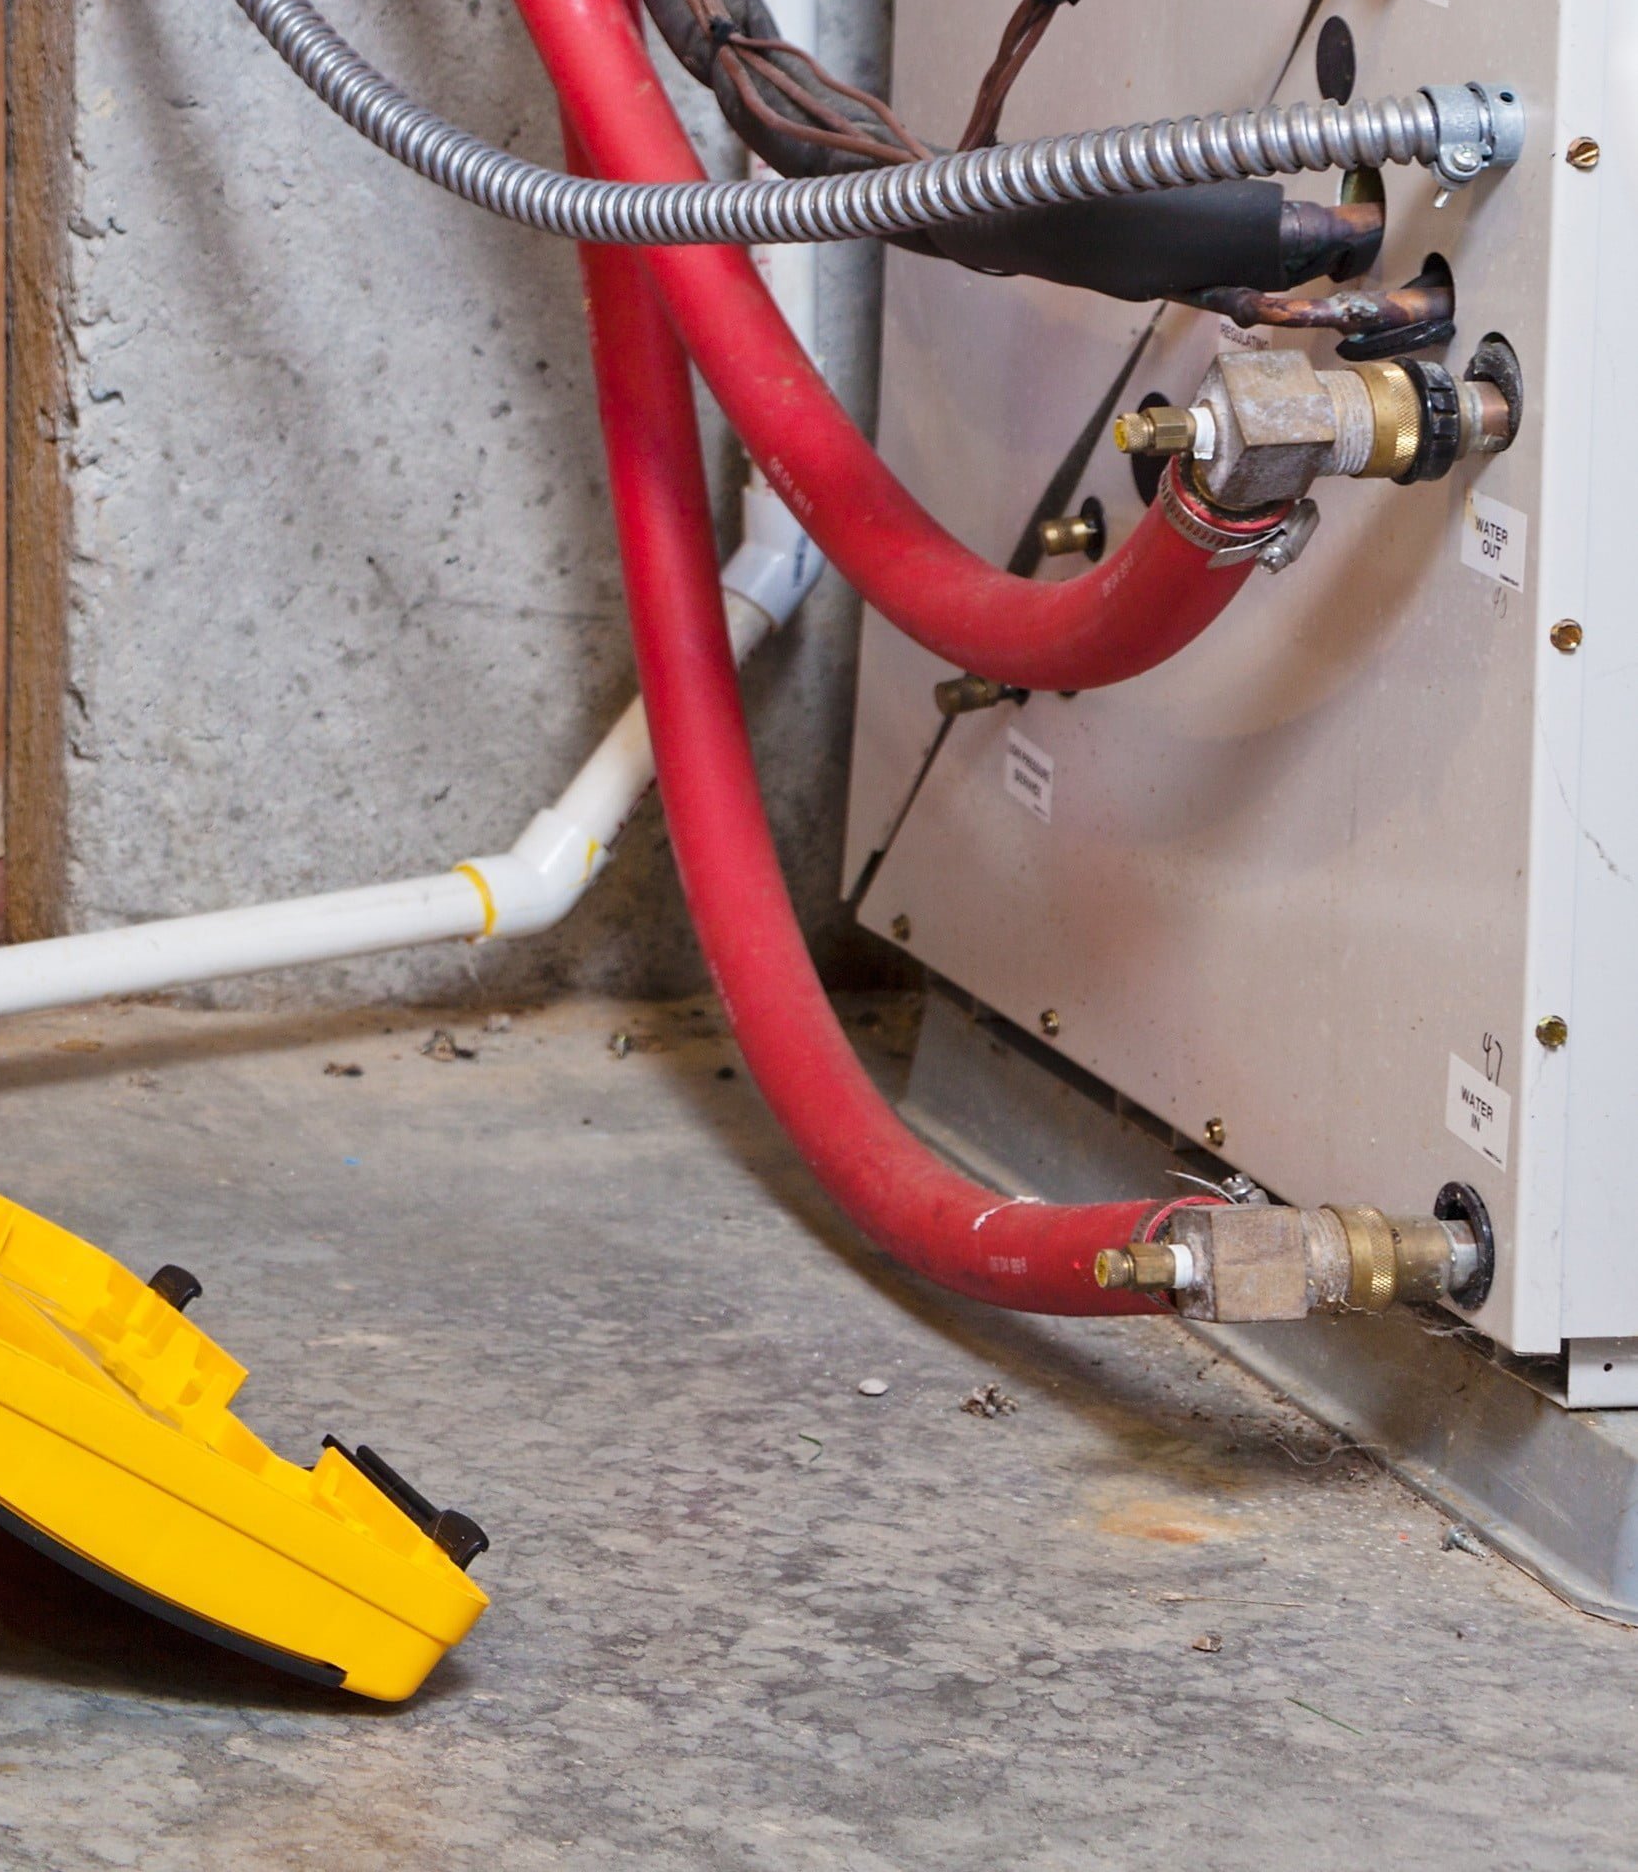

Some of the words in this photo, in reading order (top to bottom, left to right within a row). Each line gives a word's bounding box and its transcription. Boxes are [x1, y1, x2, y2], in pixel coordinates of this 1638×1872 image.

[1475, 514, 1508, 546] WATER
[1482, 539, 1502, 560] OUT
[1461, 1085, 1493, 1123] WATER
[1471, 1113, 1481, 1132] IN
